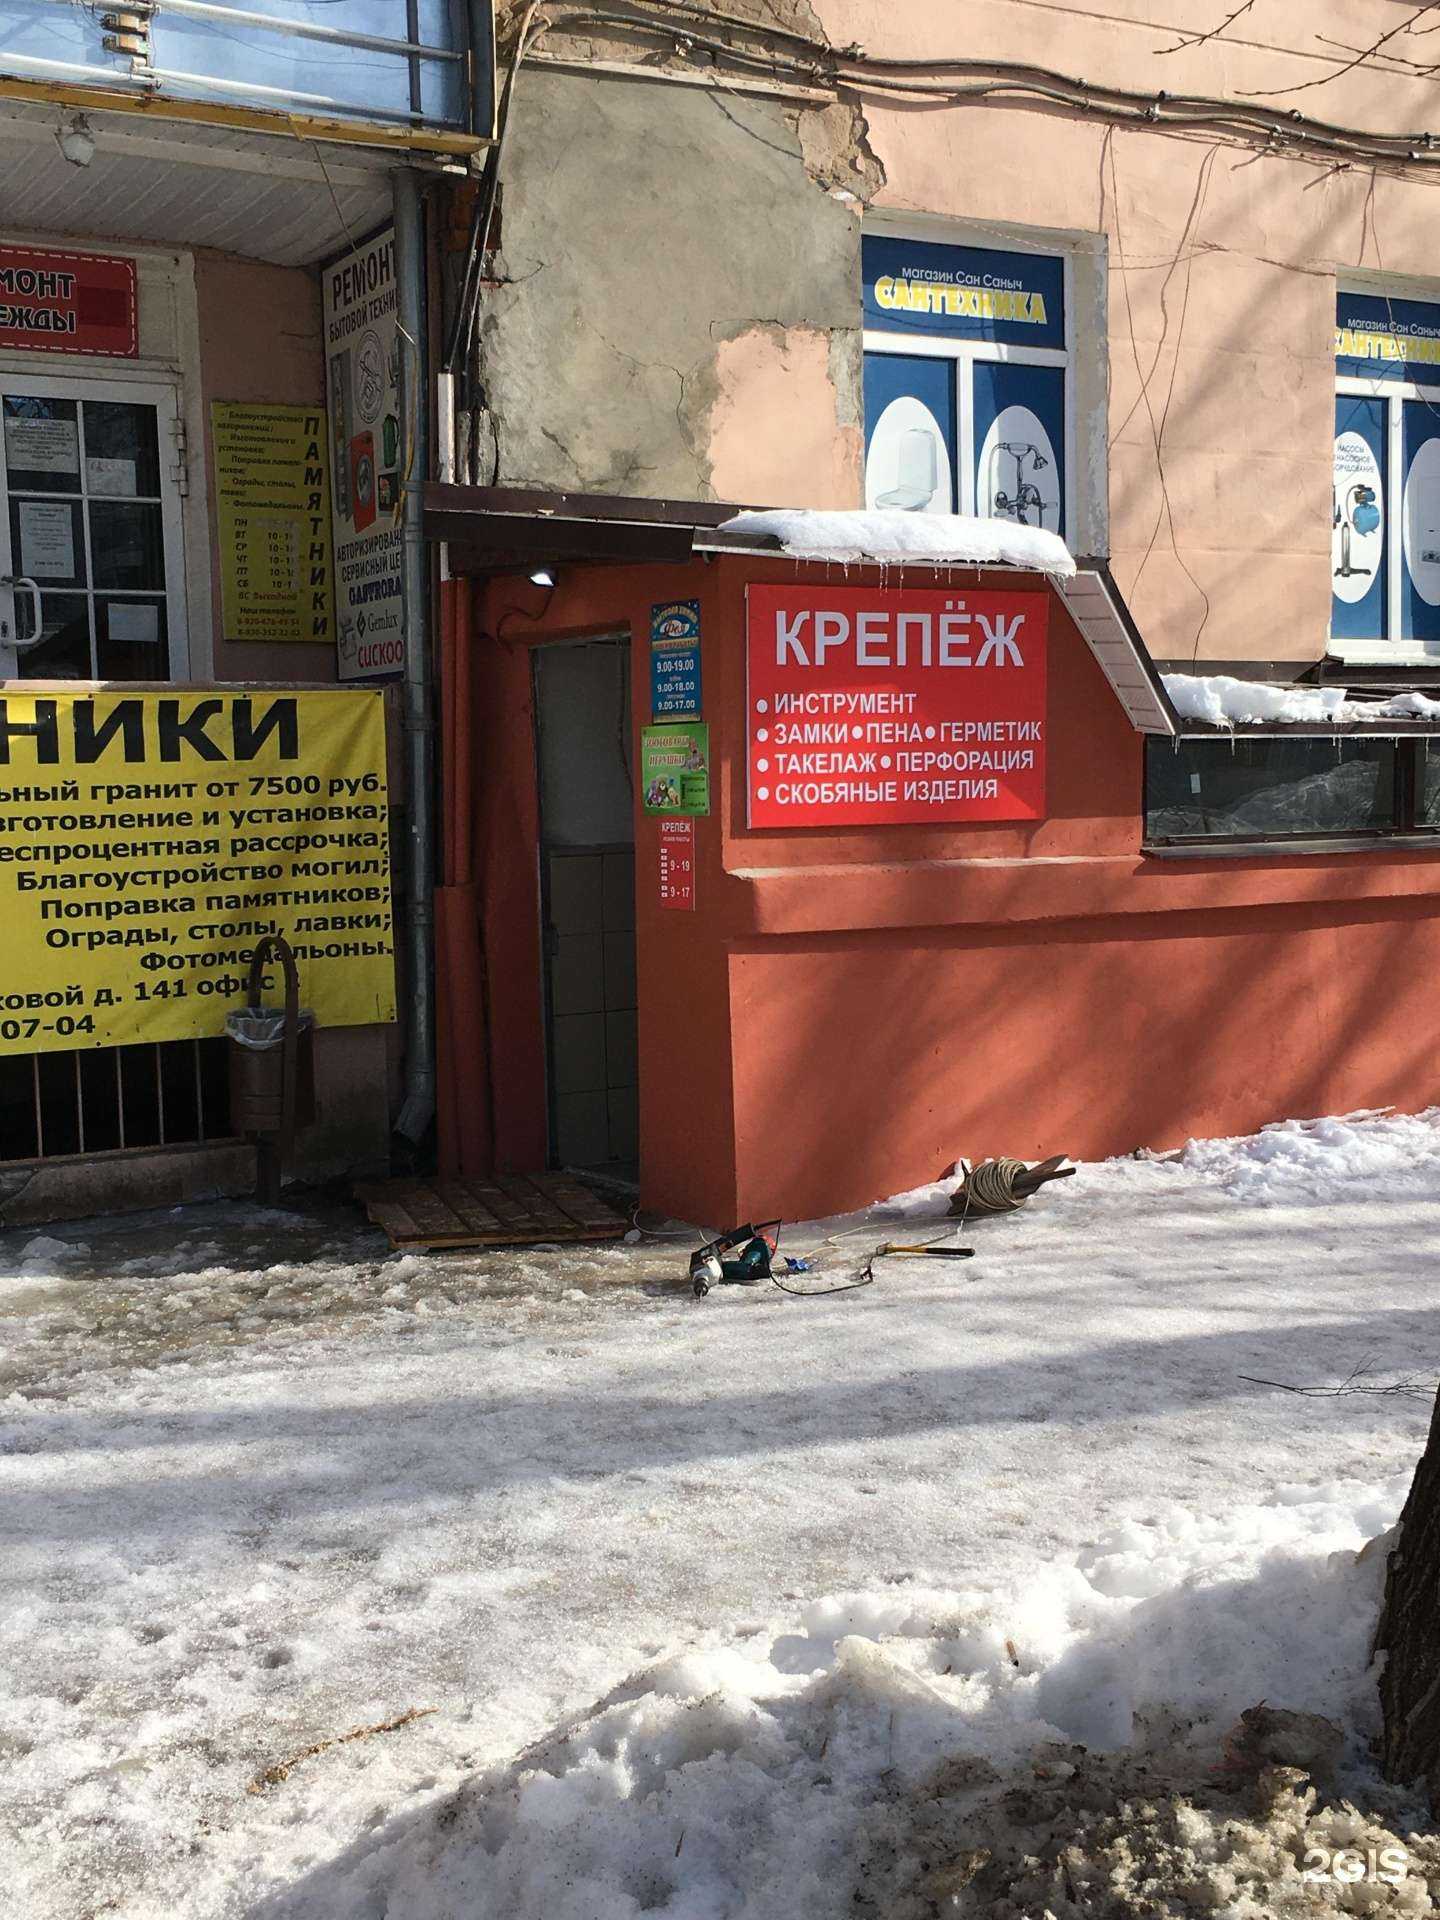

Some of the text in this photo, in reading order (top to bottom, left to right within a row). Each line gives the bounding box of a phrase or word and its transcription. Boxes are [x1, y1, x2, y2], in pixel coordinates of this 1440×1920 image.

[956, 271, 980, 286] Сан
[983, 274, 1023, 290] Саныч
[874, 275, 1047, 325] САНТЕХНИКА
[328, 301, 368, 343] БЫТОВОЙ
[342, 552, 388, 583] СЕРВИСНЫЙ
[776, 600, 1025, 667] КРЕПЁЖ
[774, 692, 917, 715] ИНСТРУМЕНТ
[0, 698, 299, 764] НИКИ
[774, 721, 1042, 744] ЗАМКИ ПЕНА ГЕРМЕТИК
[774, 750, 1034, 774] ТАКЕЛАЖ ПЕРФОРАЦИЯ
[0, 773, 388, 805] ьный гранит от 7500 руб.
[775, 779, 998, 805] СКОБЯНЫЕ ИЗДЕЛИЯ
[203, 810, 220, 826] и
[229, 804, 388, 829] установка;
[0, 832, 389, 865] еспроцентная рассрочка;
[17, 859, 389, 892] Благоустройство могил;
[41, 886, 391, 921] Поправка памятников;
[46, 913, 393, 951] Ограды, столы, лавки;
[0, 984, 84, 1011] овой
[94, 986, 122, 1007] д.
[134, 978, 187, 1001] 141
[1, 1014, 96, 1040] 07-04
